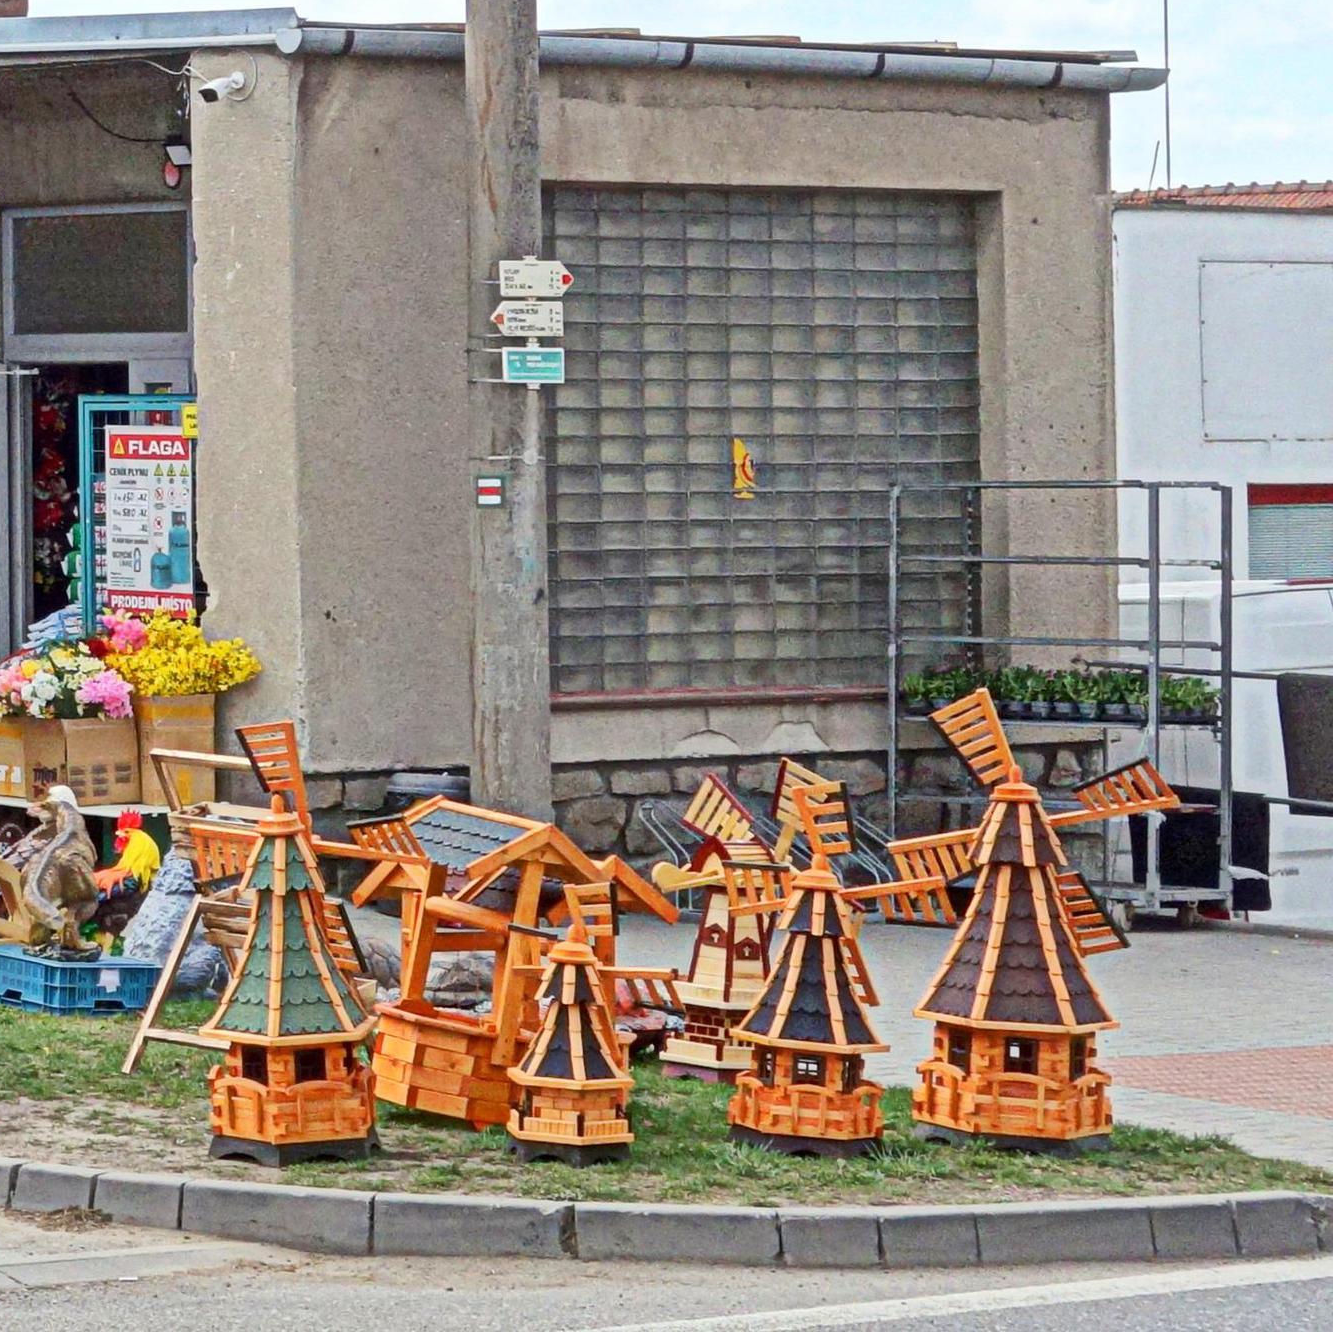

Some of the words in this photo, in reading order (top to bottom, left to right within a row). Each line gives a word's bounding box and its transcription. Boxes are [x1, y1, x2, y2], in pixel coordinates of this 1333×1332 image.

[128, 440, 185, 455] FLAGA
[110, 594, 159, 609] PRODEJNÍ
[160, 596, 192, 611] MÍSTO
